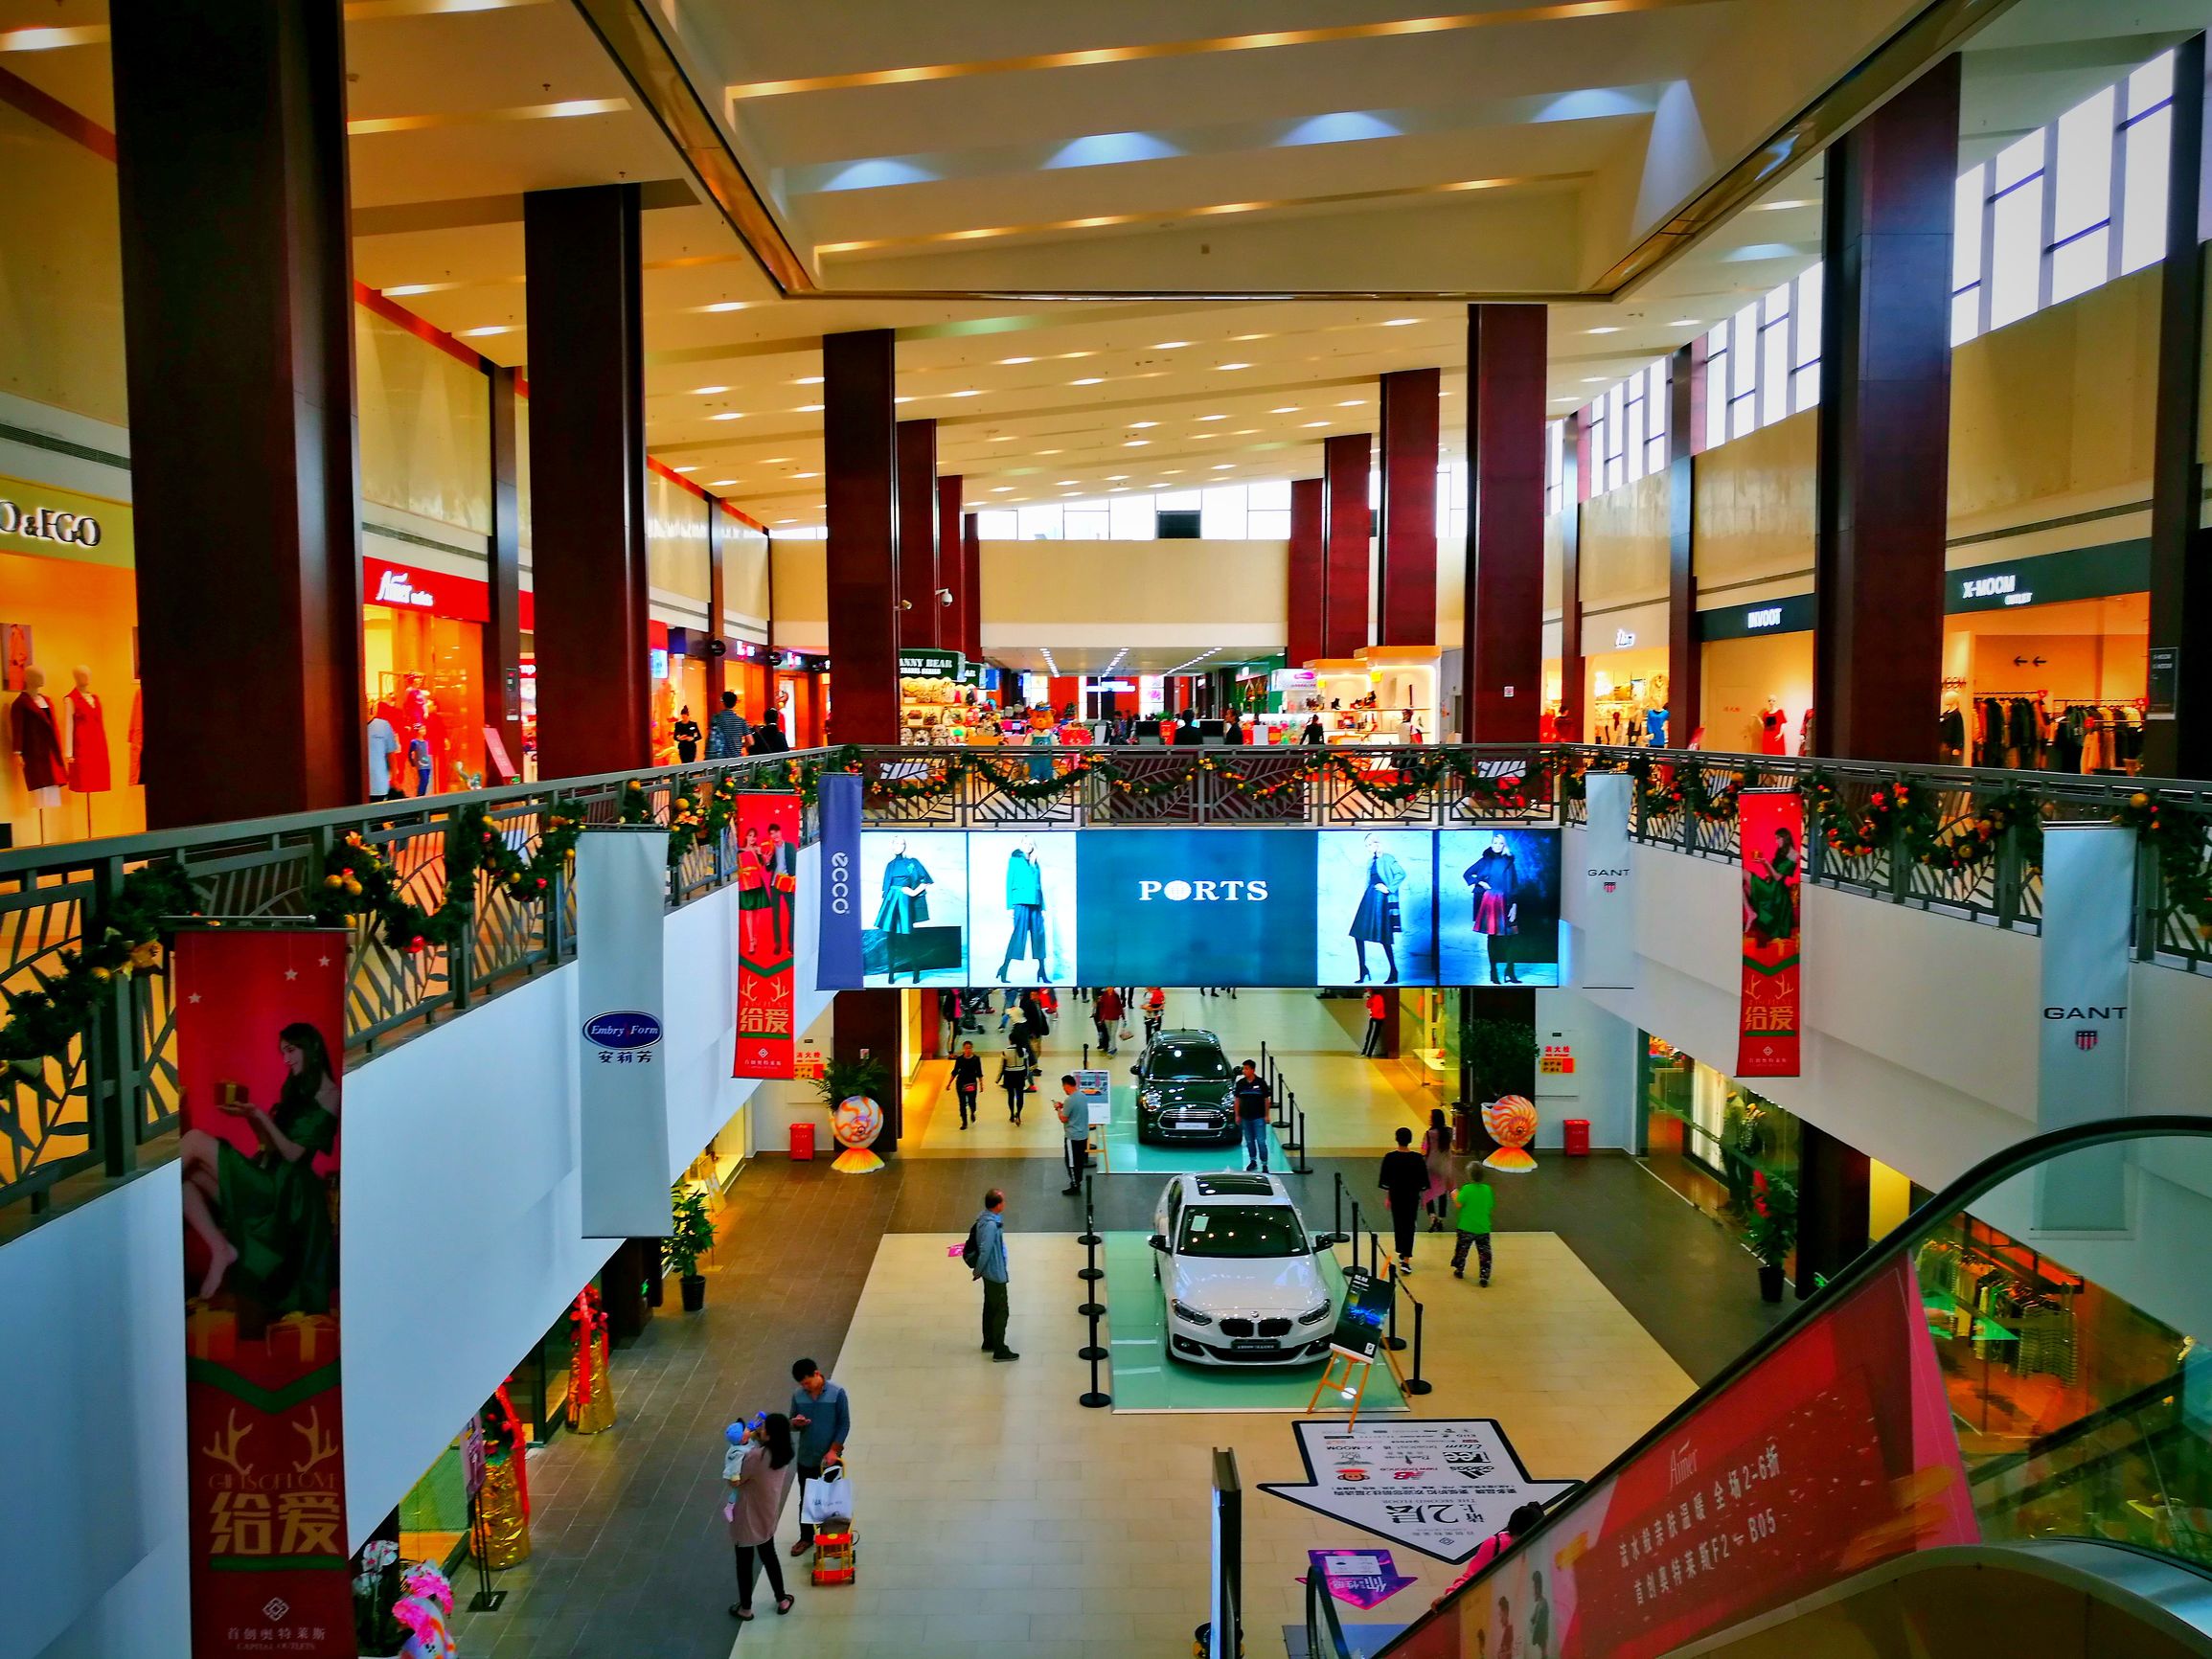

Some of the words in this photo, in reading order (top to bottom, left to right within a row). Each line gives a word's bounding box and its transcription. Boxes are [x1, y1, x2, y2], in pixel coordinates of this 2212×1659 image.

[1962, 575, 2017, 599] X-MOOM
[899, 658, 924, 668] ANNY
[925, 658, 953, 668] BEAR
[832, 852, 850, 915] ecco
[1138, 880, 1268, 901] PORTS
[740, 1007, 789, 1034] 给爱
[1745, 1006, 1794, 1031] 给爱
[2043, 1007, 2128, 1020] GANT
[590, 1025, 626, 1037] Embry
[629, 1025, 659, 1034] Form
[598, 1050, 653, 1064] 安莉芳
[1443, 1452, 1491, 1463] Lee
[209, 1490, 342, 1556] 给爱
